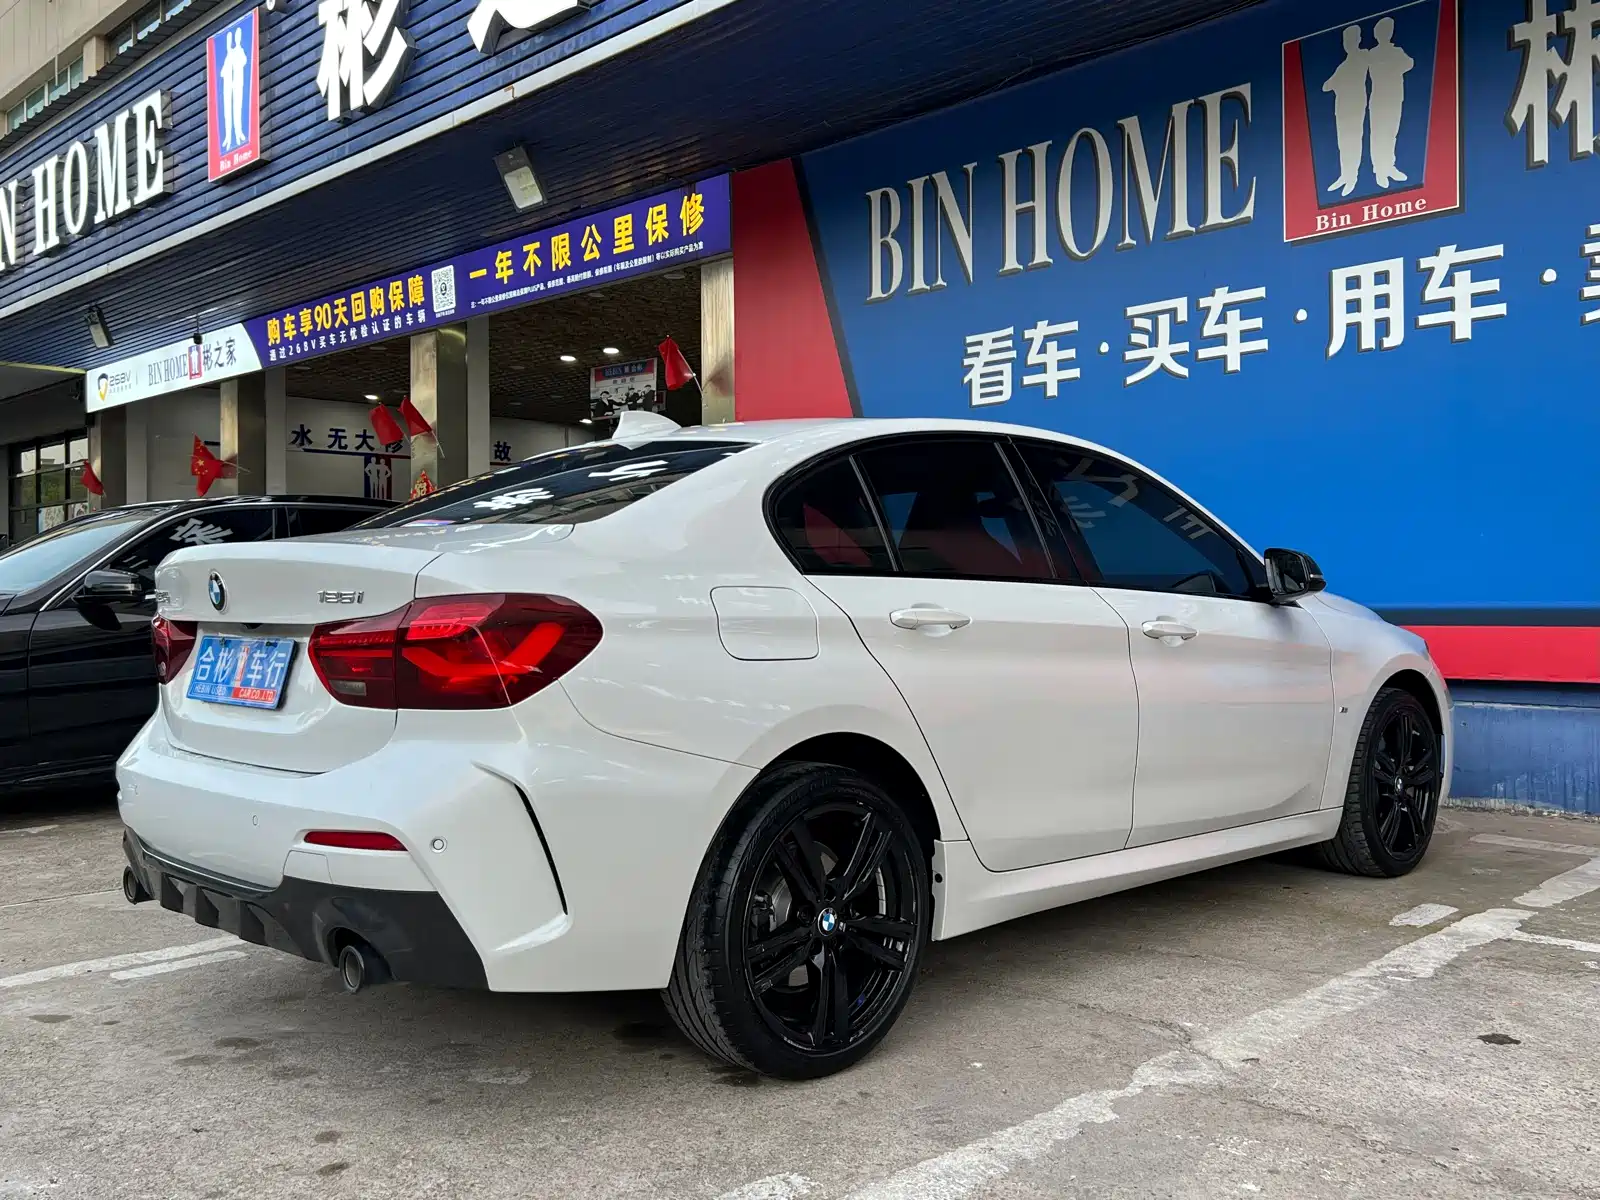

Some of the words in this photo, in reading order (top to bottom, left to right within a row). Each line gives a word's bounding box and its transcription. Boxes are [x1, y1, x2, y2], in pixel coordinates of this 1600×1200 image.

[31, 90, 165, 256] HOME
[219, 159, 232, 172] Bin
[233, 149, 253, 165] Home
[865, 162, 978, 302] BIN
[998, 82, 1257, 277] HOME
[1315, 212, 1352, 232] Bin
[1361, 198, 1427, 222] Home
[469, 193, 705, 285] 一年不限公里保修
[267, 274, 425, 346] 购车享90天回购保障
[148, 360, 163, 386] BIN
[164, 353, 188, 383] HOME
[202, 337, 237, 371] 彬之家
[109, 370, 131, 387] 268V
[290, 424, 313, 447] 水
[494, 441, 512, 462] 故
[247, 650, 287, 688] 车行
[239, 688, 251, 699] CAR
